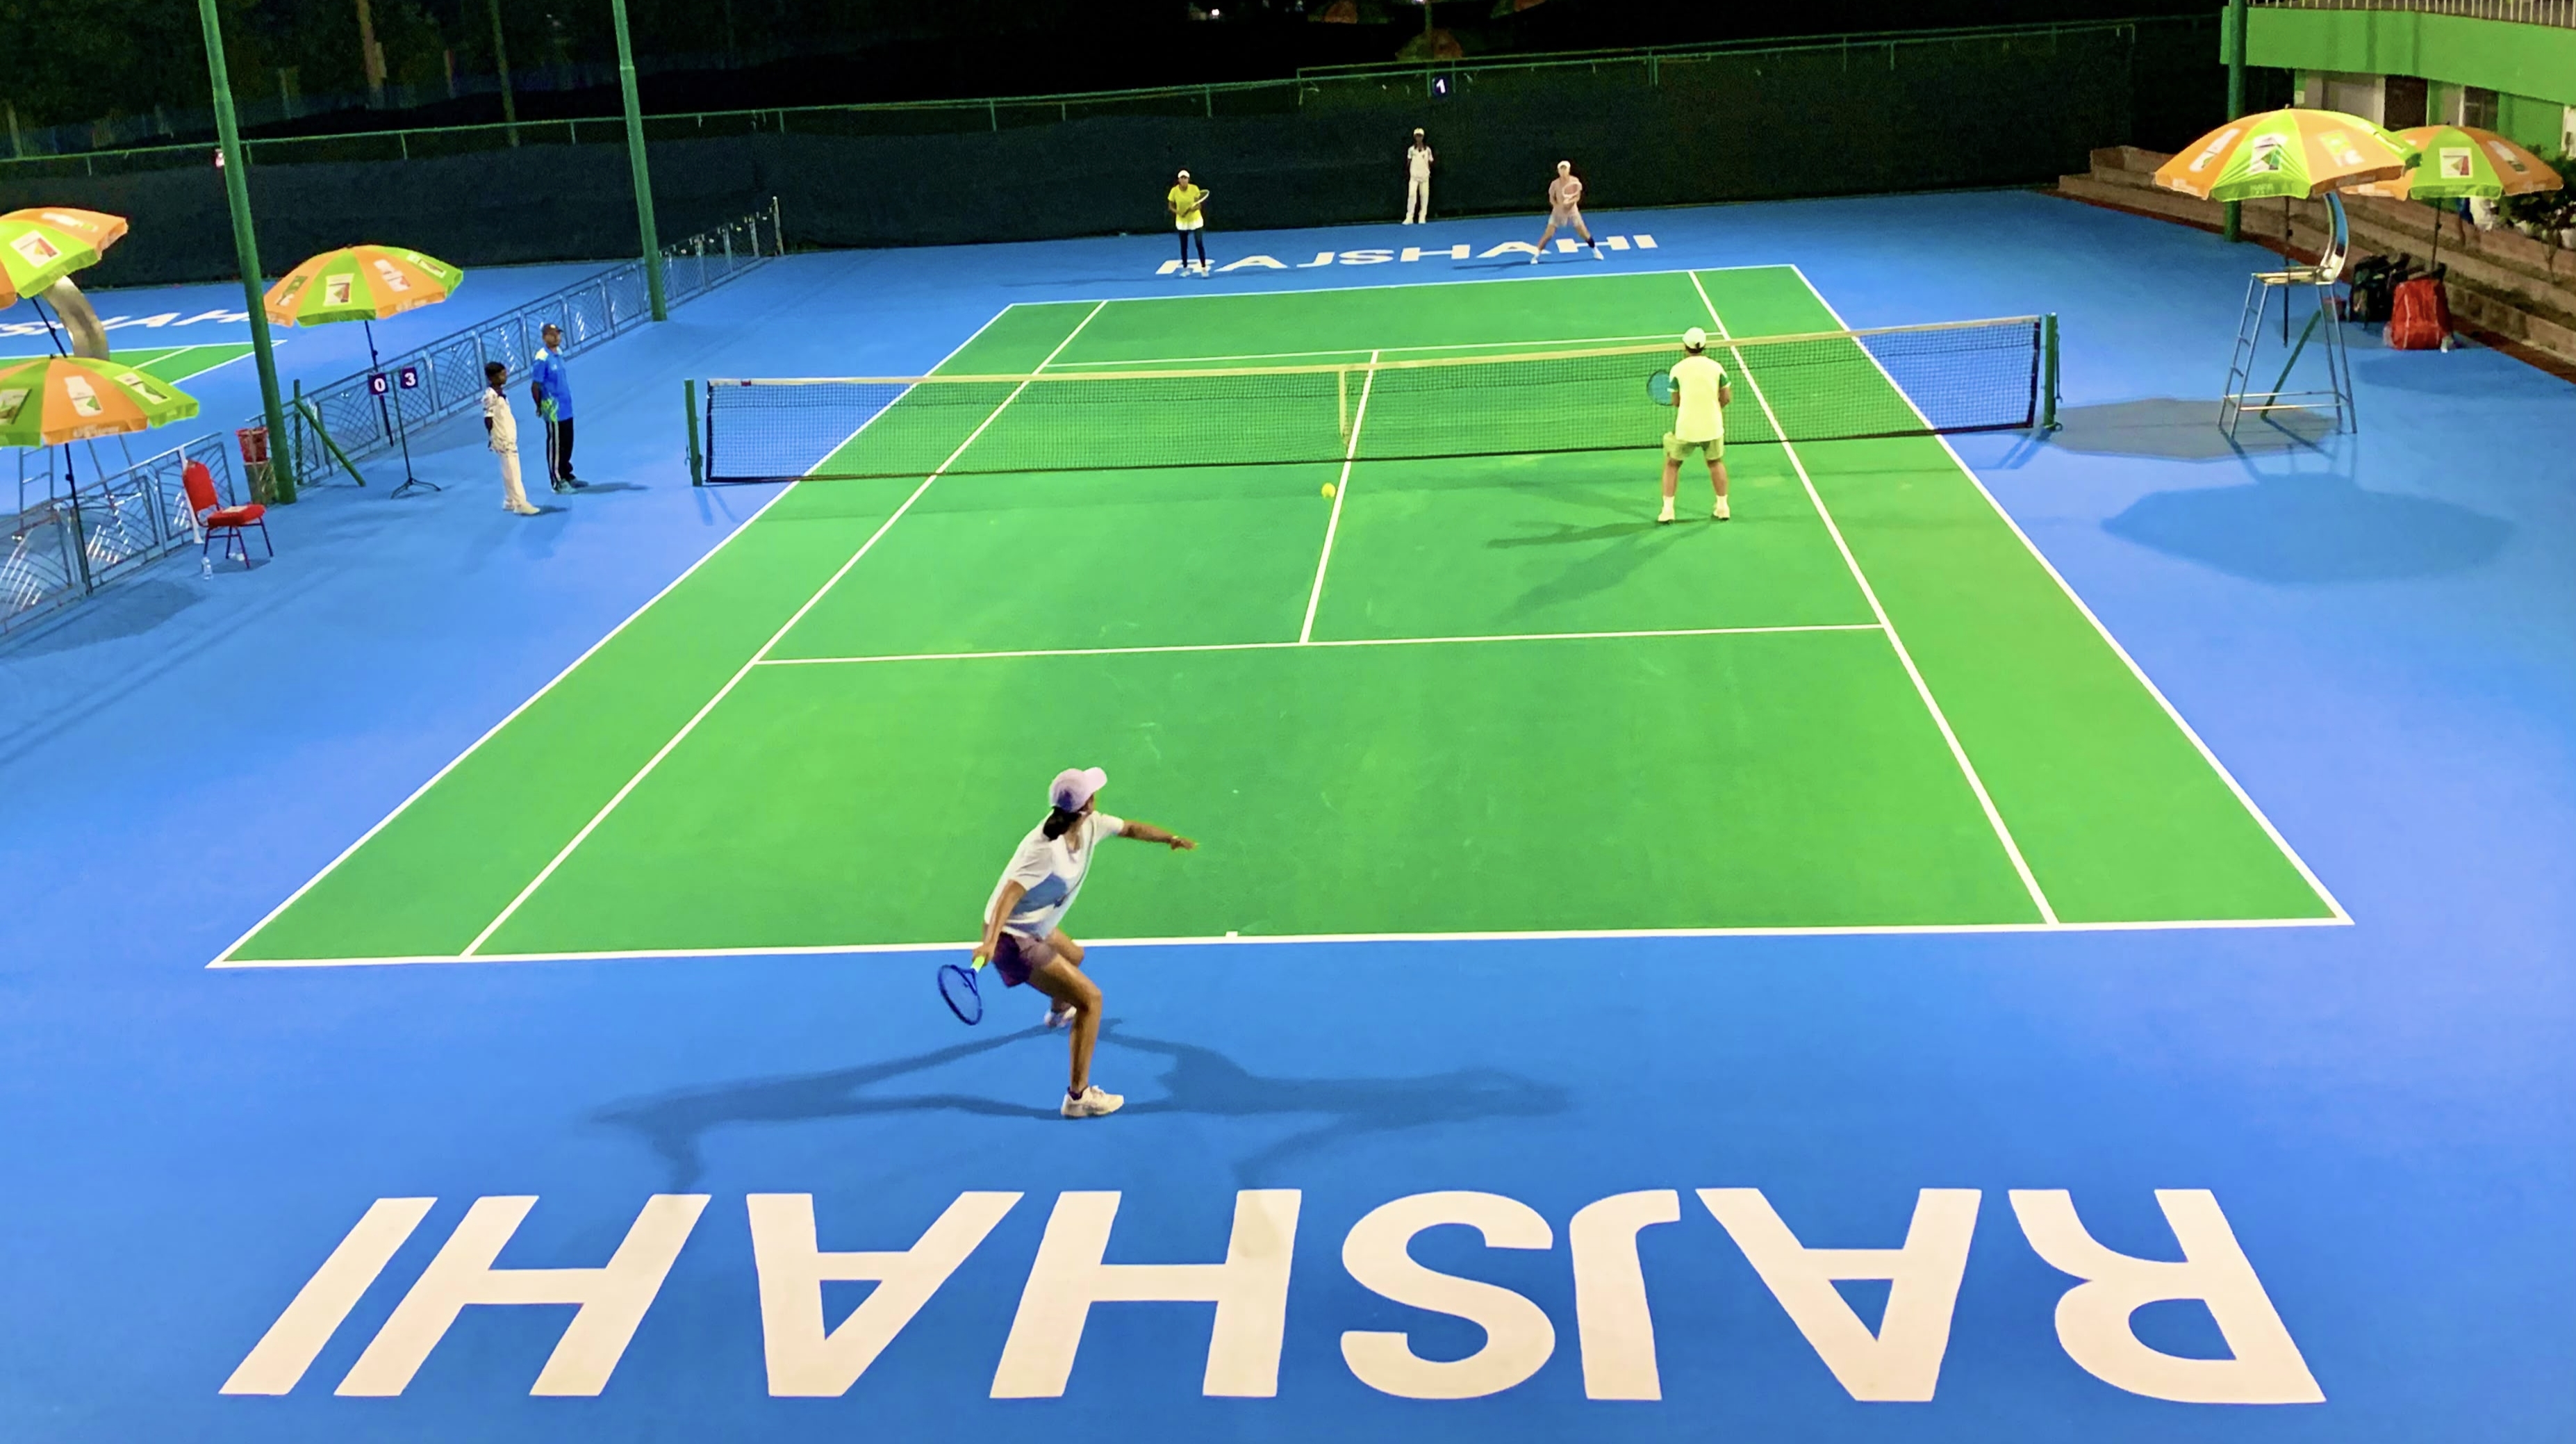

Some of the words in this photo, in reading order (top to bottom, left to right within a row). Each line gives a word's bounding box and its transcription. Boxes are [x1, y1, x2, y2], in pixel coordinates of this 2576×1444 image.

[1436, 79, 1446, 94] 1
[1155, 234, 1658, 274] RAJSHAHI
[374, 378, 386, 392] 0
[404, 372, 416, 386] 3
[218, 1188, 2327, 1405] RAJSHAHI
